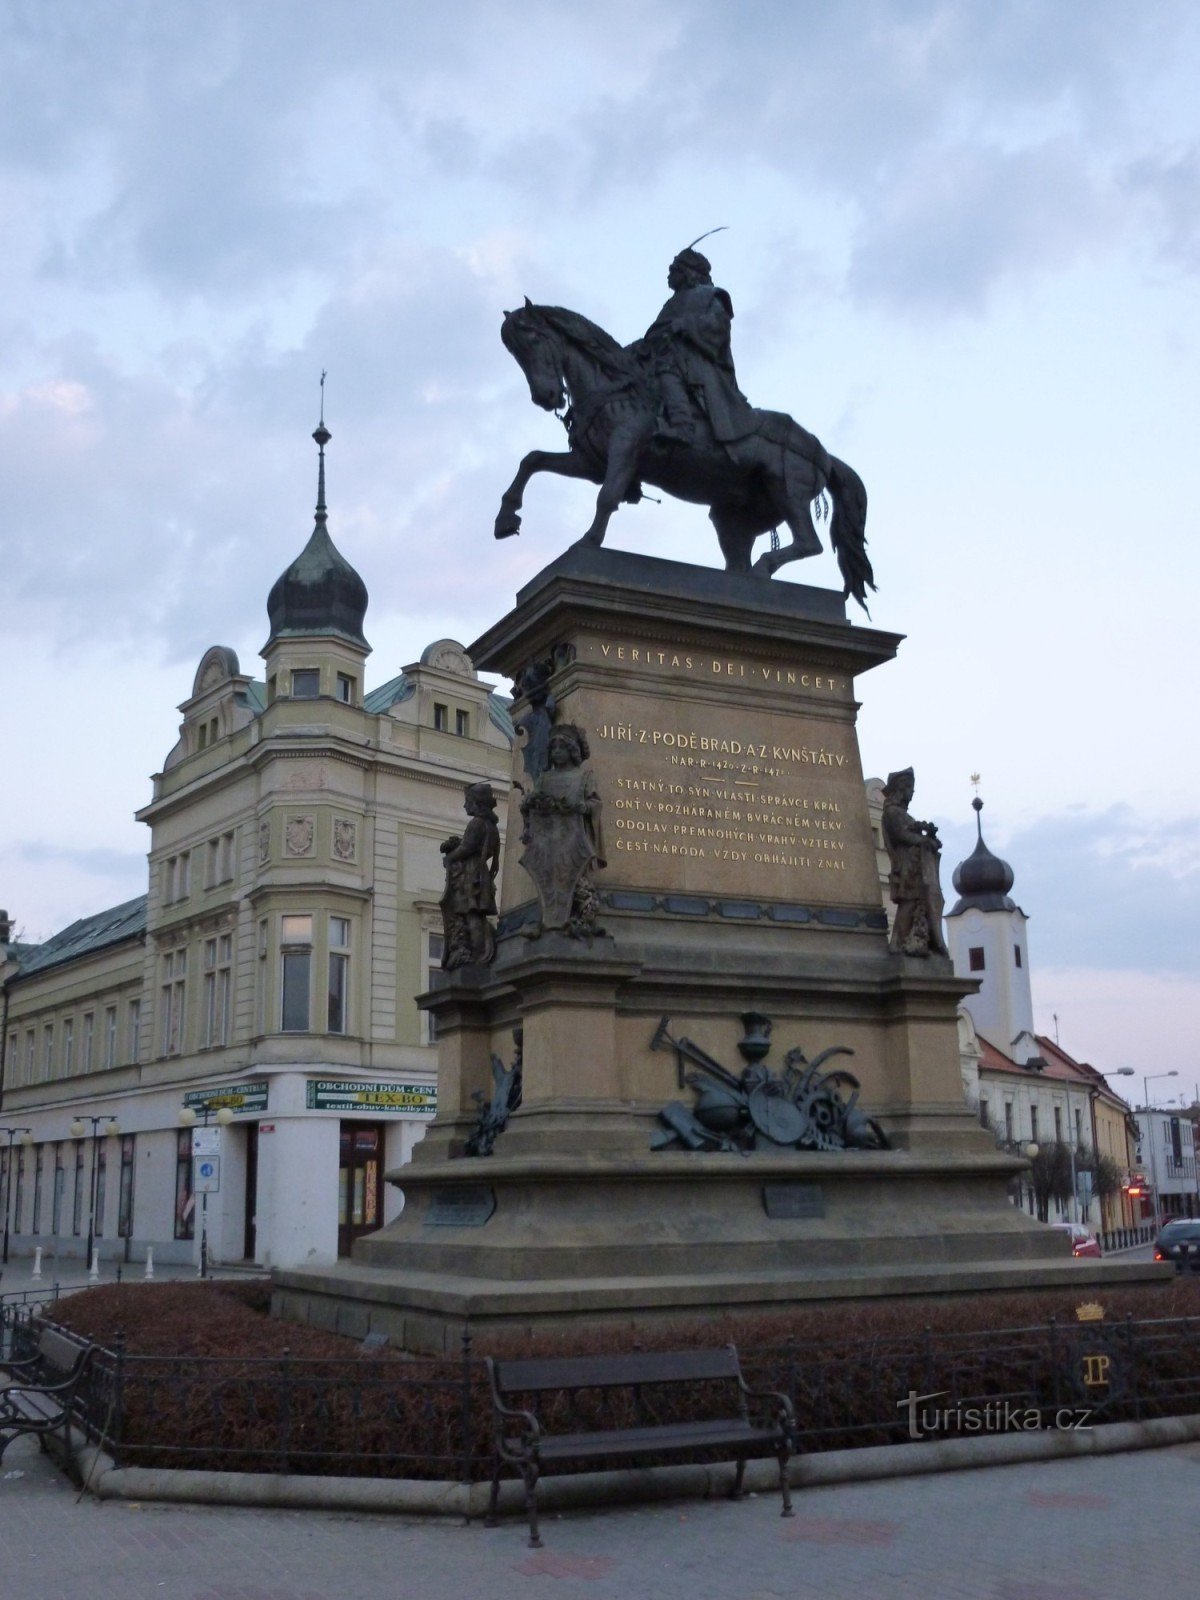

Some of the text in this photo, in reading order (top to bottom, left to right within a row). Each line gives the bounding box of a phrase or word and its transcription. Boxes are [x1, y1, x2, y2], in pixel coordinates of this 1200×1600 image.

[601, 644, 836, 691] VERITAS DEI VINCET
[600, 722, 844, 767] JIŘÍ Z PODĚBRAD A Z KVNŠTÁTV
[671, 755, 693, 766] NAR
[617, 778, 664, 793] STATNÝ
[668, 784, 684, 794] TO
[688, 786, 710, 797] SYN
[760, 793, 809, 809] SPRÁVCE
[645, 802, 653, 811] V
[616, 819, 668, 833] ODOLAV
[801, 837, 844, 851] VZTEKV
[653, 840, 705, 858] NÁRODA
[818, 859, 847, 871] ZNAL
[317, 1081, 377, 1092] OBCHODNÍ
[361, 1092, 424, 1104] TEX-BO
